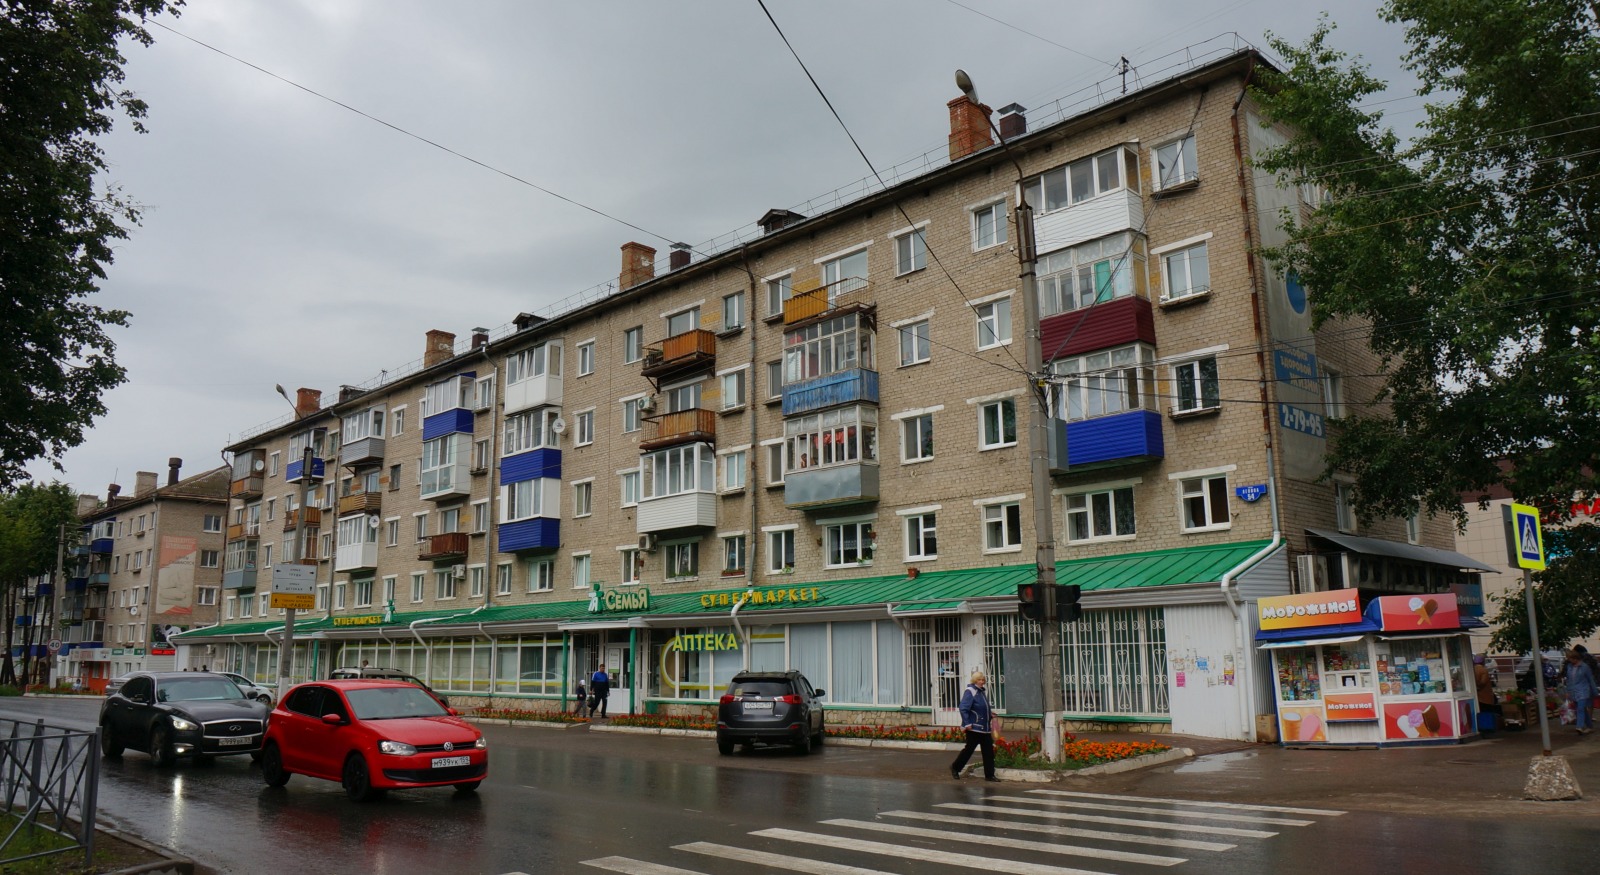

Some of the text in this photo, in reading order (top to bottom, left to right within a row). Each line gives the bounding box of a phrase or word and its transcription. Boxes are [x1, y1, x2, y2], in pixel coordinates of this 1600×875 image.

[1282, 404, 1323, 437] 2-79-95
[701, 587, 819, 607] СУПЕРМАРКЕТ
[1261, 599, 1357, 620] МОРОЖЕНОЕ
[672, 633, 739, 652] АПТЕКА
